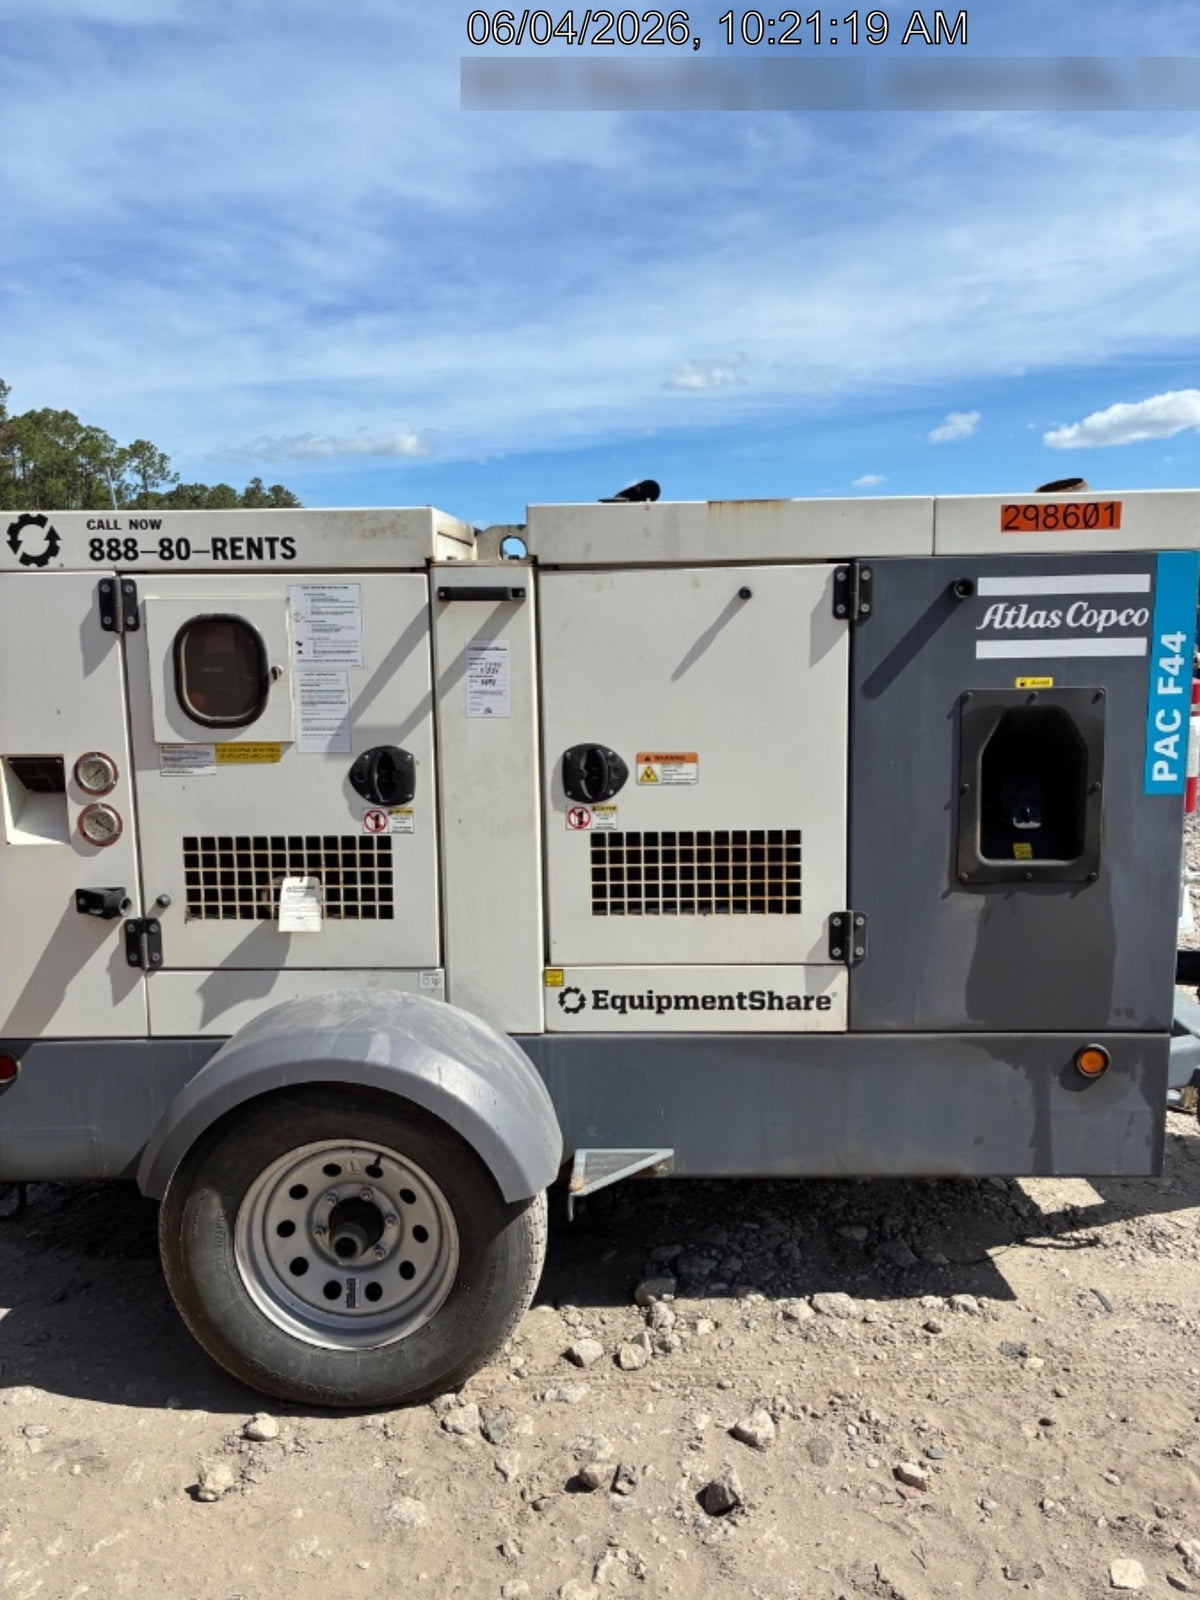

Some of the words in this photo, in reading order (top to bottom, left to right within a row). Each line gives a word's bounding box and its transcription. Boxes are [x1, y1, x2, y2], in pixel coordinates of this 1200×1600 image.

[86, 518, 122, 531] CALL
[128, 518, 163, 531] NOW
[1003, 501, 1115, 530] 298601
[975, 602, 1063, 630] Atlas
[1065, 601, 1150, 634] Copco
[1156, 630, 1187, 695] F44
[1151, 708, 1182, 782] PAC
[591, 989, 832, 1015] EquipmentShare
